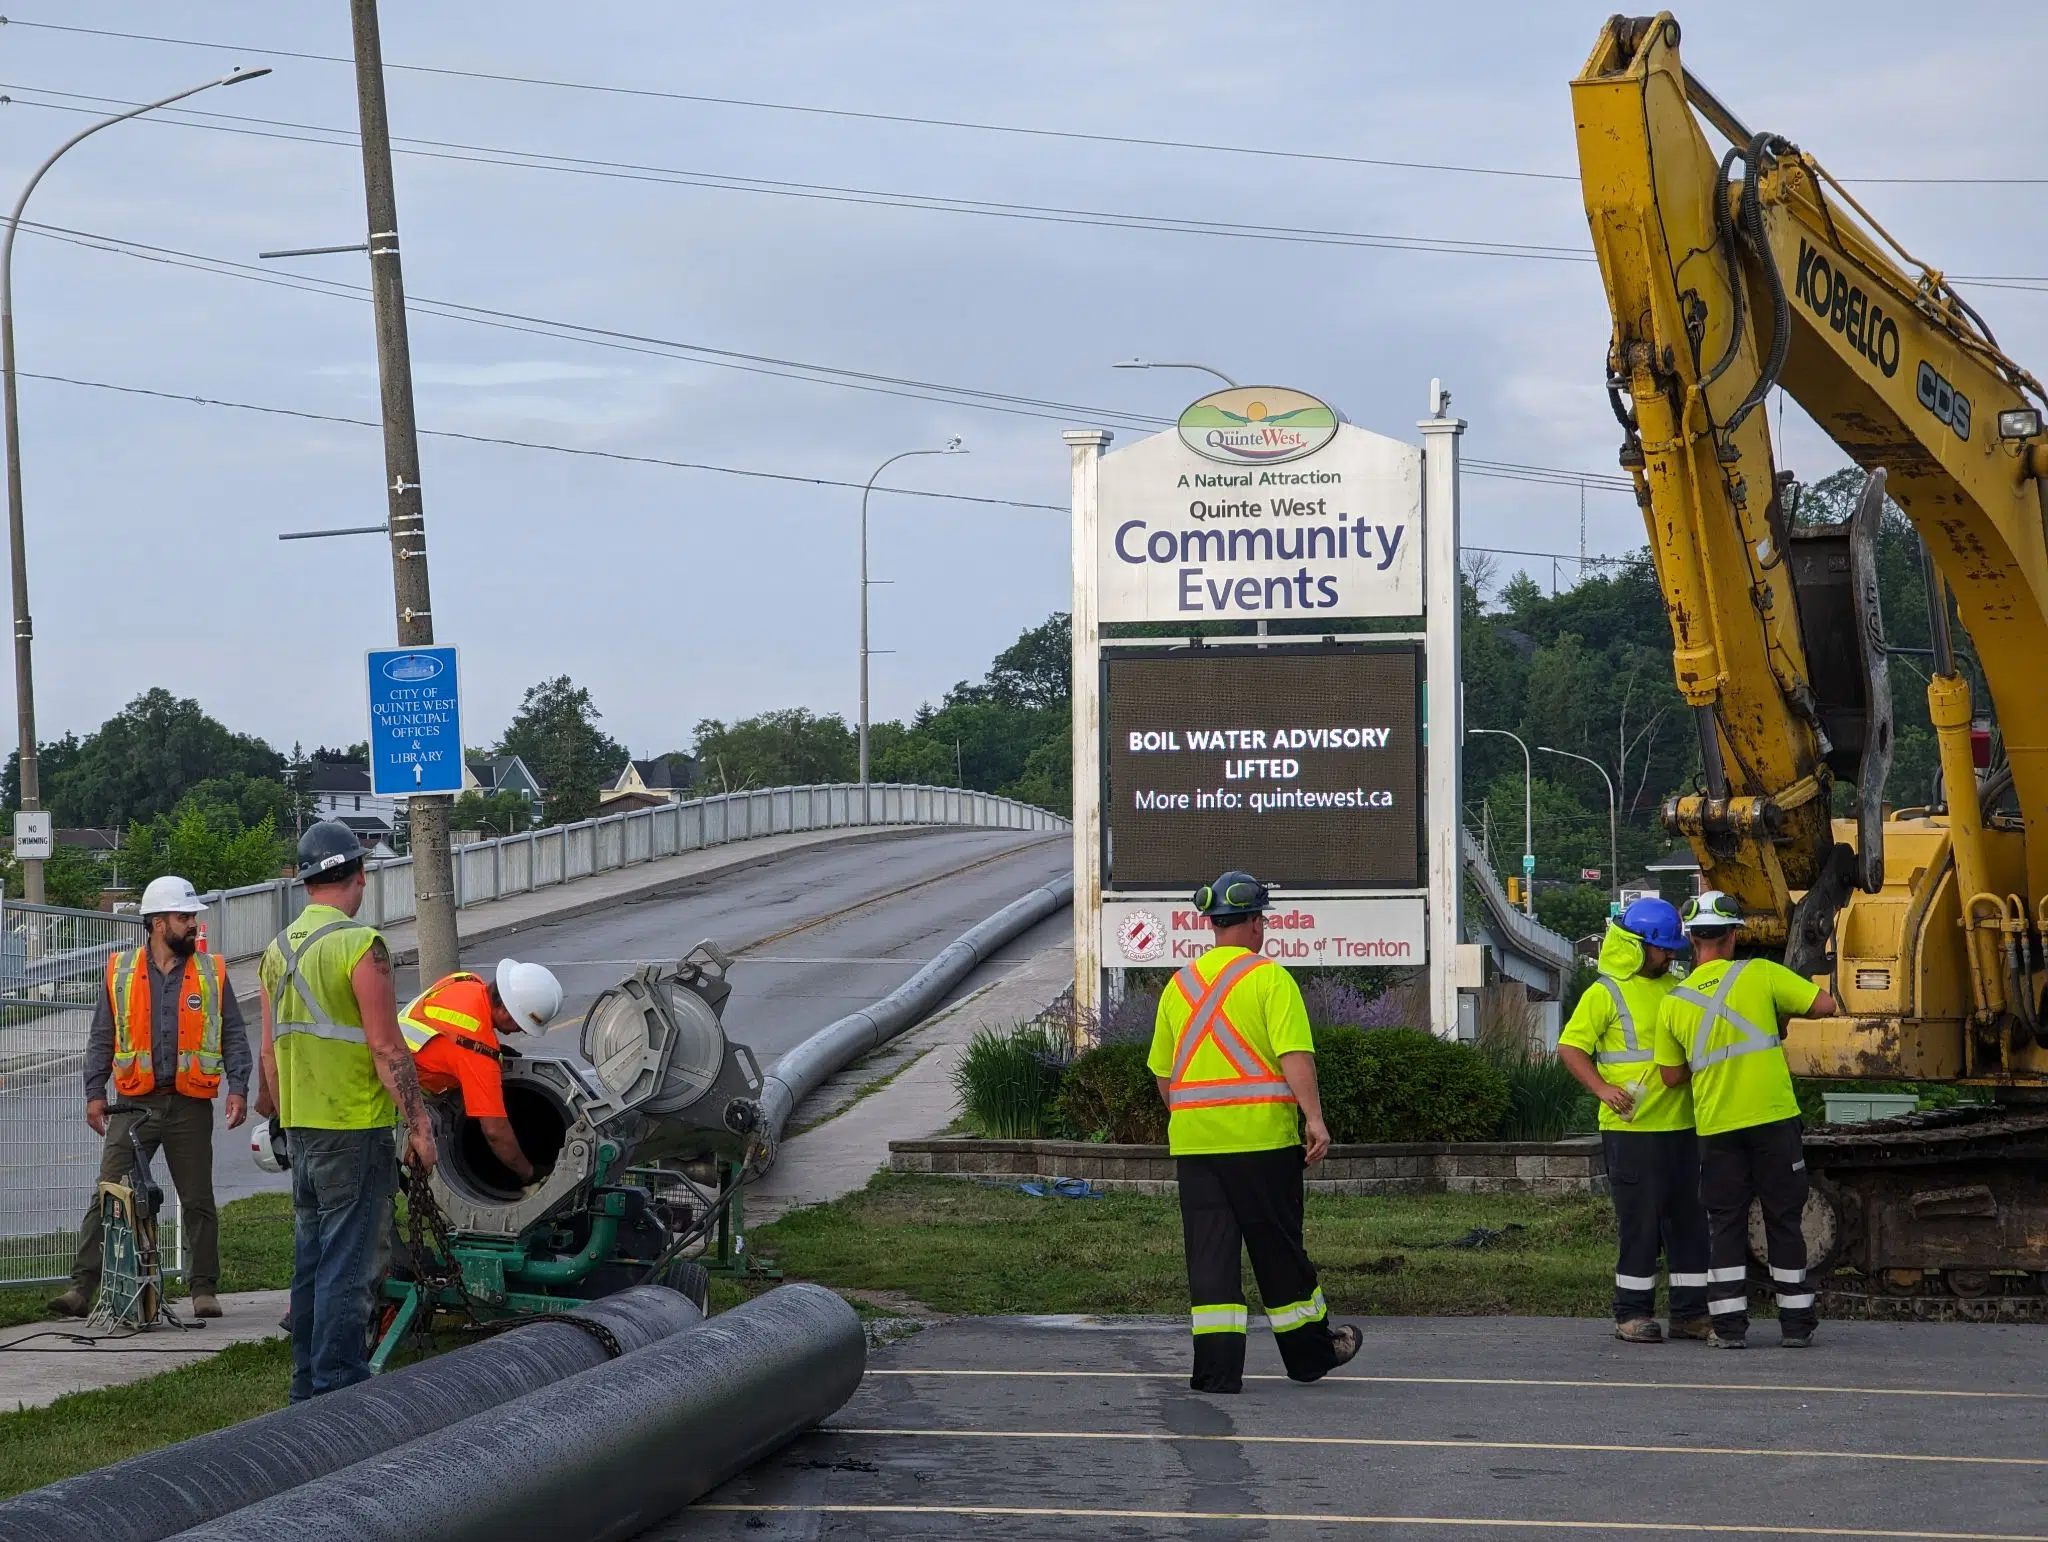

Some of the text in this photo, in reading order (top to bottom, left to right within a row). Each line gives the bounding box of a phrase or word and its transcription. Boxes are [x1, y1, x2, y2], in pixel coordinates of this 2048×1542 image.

[1795, 237, 1900, 379] KOBELCO
[1916, 359, 1971, 442] CDS
[1177, 470, 1341, 488] A Natural Attraction
[1189, 497, 1327, 522] Quinte West
[1114, 512, 1405, 571] Community
[1178, 566, 1339, 612] Events
[390, 687, 438, 700] CITY OF
[373, 698, 456, 715] QUINTE WEST
[381, 713, 449, 727] MUNICIPAL
[392, 725, 440, 738] OFFICES
[1129, 727, 1391, 751] BOIL WATER ADVISORY
[412, 740, 421, 750] &
[391, 751, 443, 763] LIBRARY
[1225, 758, 1299, 779] LIFTED
[1135, 787, 1393, 813] More info: quintewest.ca
[28, 825, 37, 833] NO
[17, 836, 48, 846] SWIMMING
[1264, 937, 1309, 959] Club
[1313, 937, 1327, 951] of
[1332, 937, 1410, 958] Trenton
[1697, 977, 1720, 991] CDS
